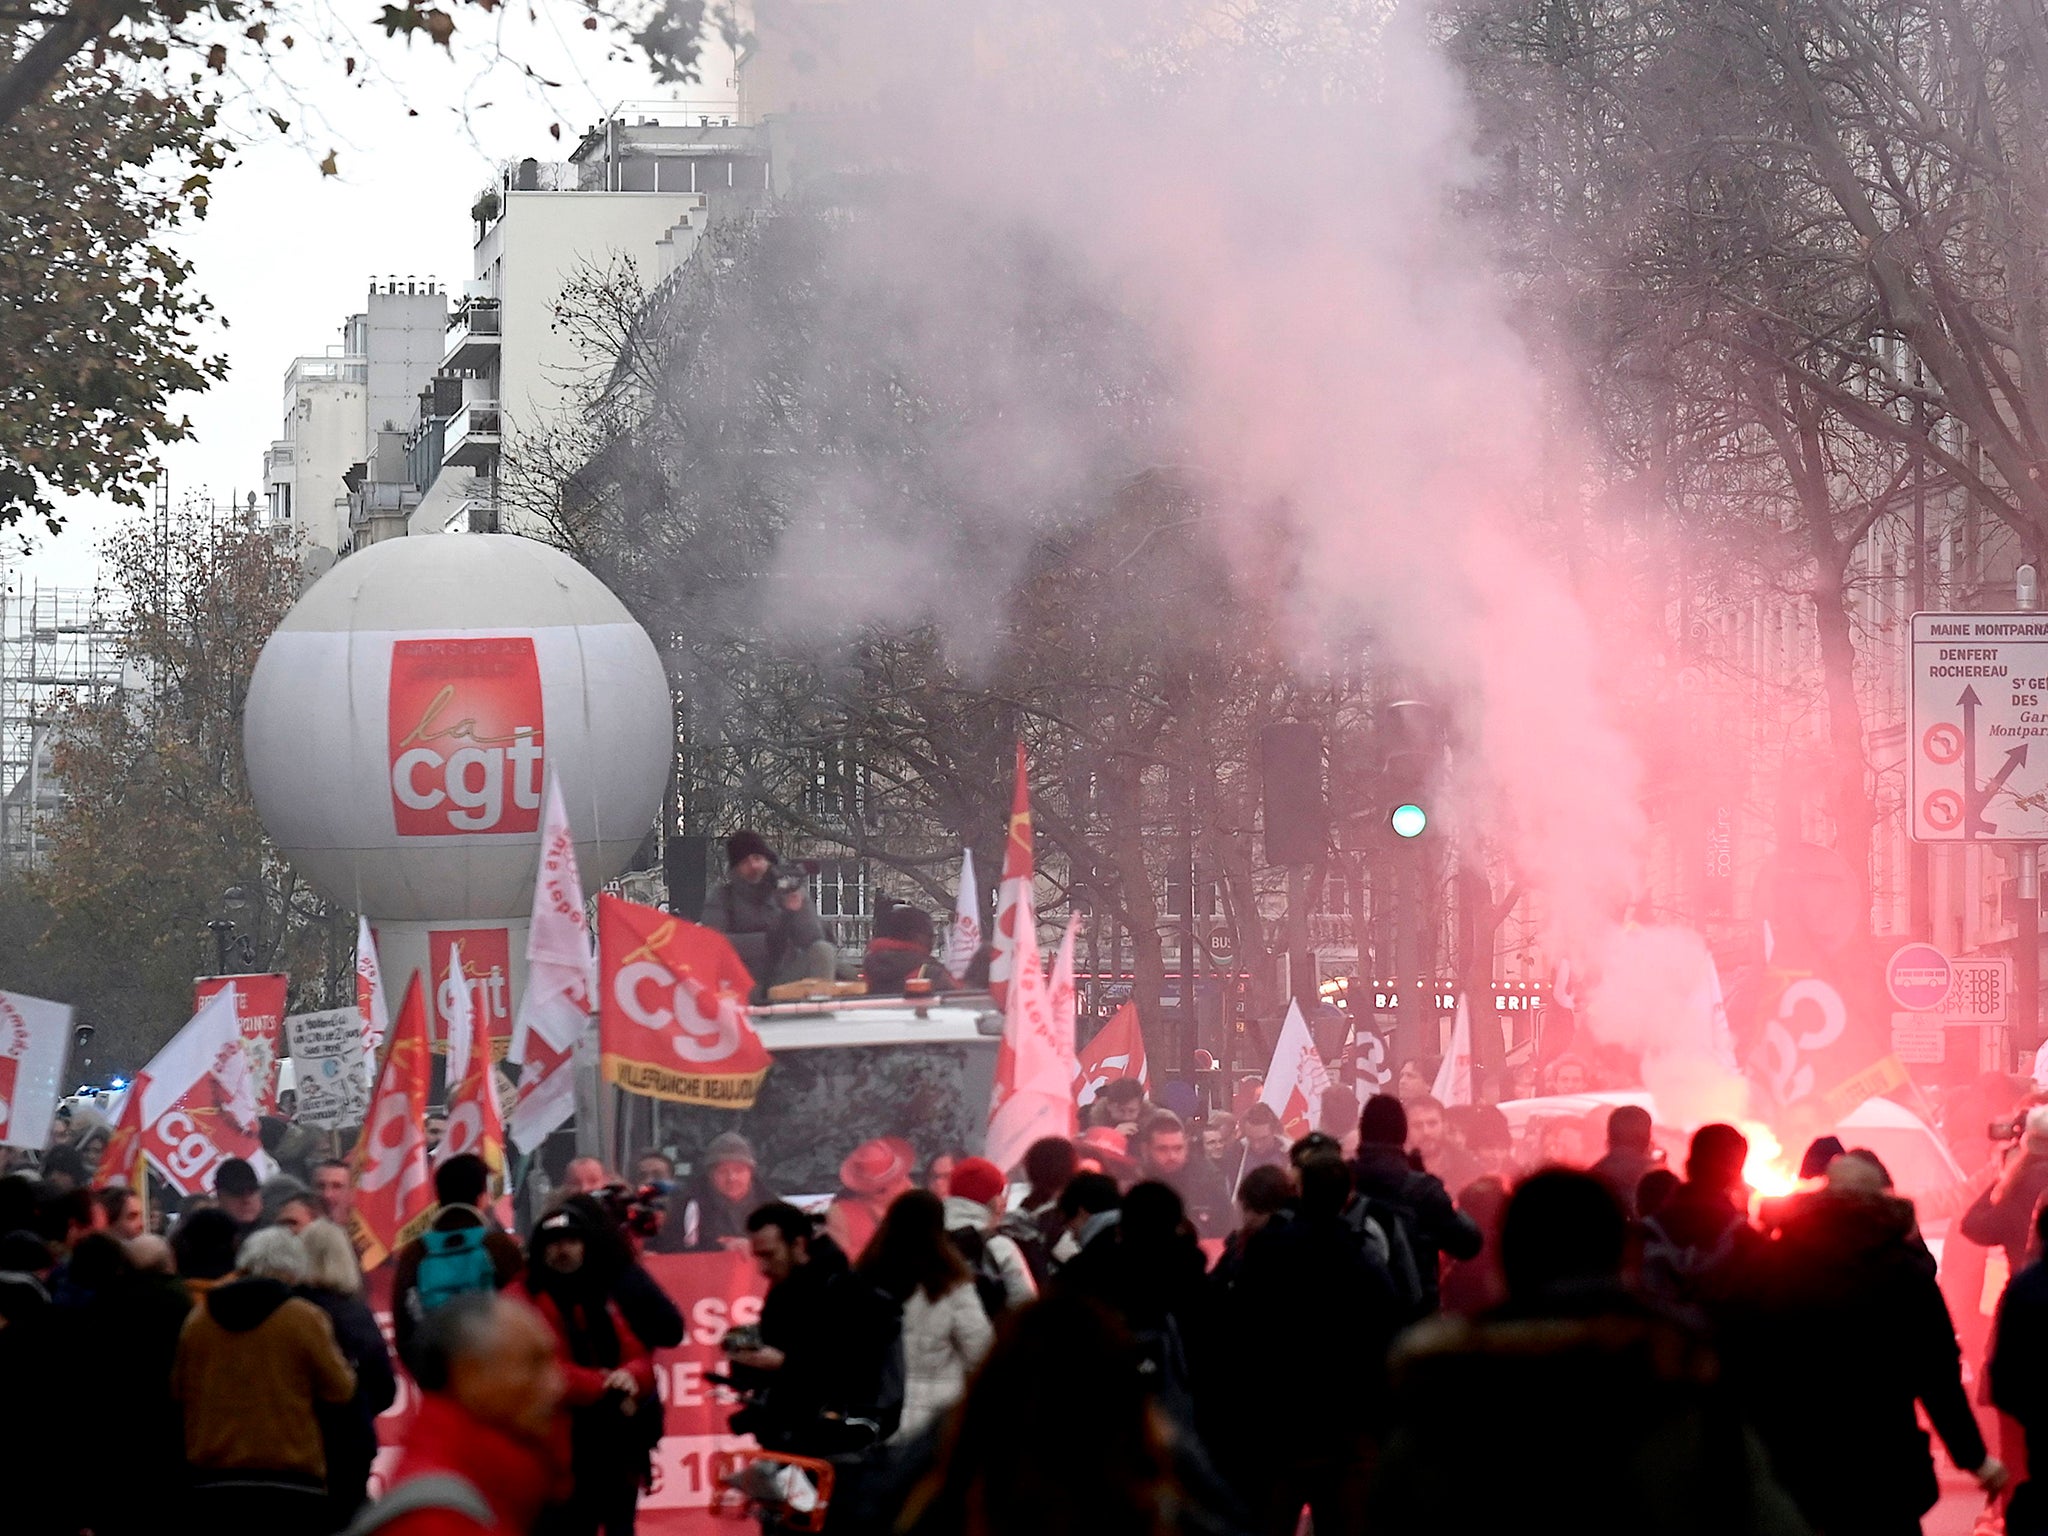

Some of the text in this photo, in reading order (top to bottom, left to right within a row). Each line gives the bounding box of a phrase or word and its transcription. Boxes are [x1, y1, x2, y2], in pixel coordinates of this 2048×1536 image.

[1930, 624, 1970, 636] MAINE
[1939, 649, 1998, 661] DENFERT
[1930, 665, 2008, 677] ROCHEREAU
[2028, 678, 2048, 689] GE
[2012, 695, 2038, 706] DES
[400, 684, 546, 748] la
[392, 726, 544, 831] cgt
[1954, 969, 1999, 981] Y-TOP
[1375, 993, 1399, 1008] BA
[1946, 991, 1999, 1003] PY-TOP
[1936, 1002, 1999, 1014] OPY-TOP
